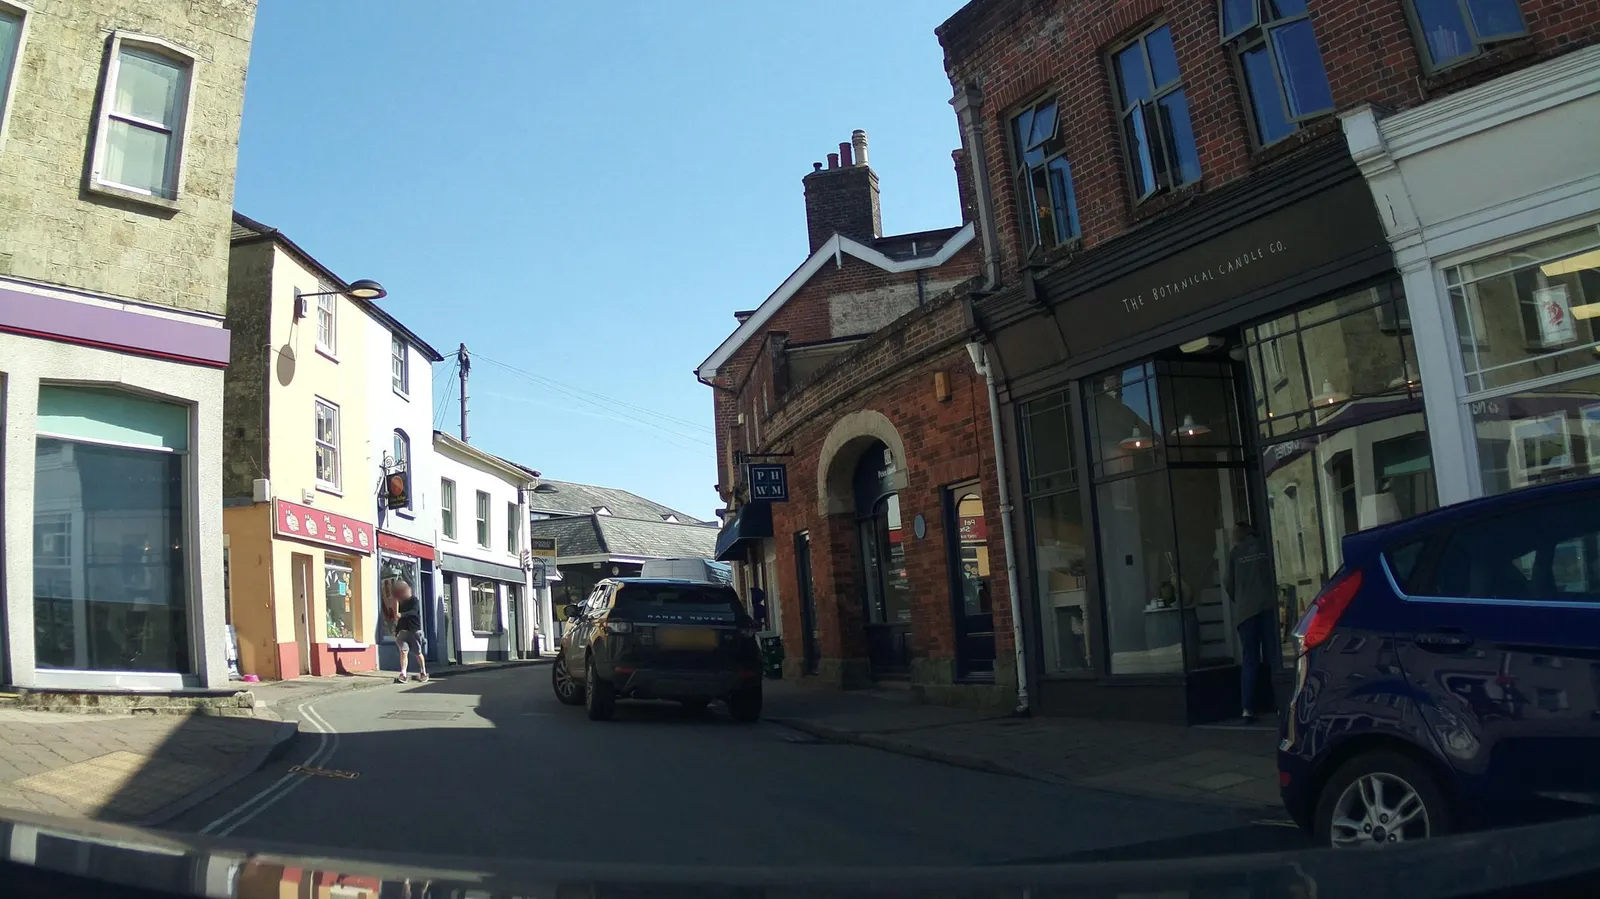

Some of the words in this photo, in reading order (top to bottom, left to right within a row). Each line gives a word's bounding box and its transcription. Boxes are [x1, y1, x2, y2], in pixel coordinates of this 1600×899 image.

[1122, 295, 1145, 313] THE
[1152, 269, 1214, 301] BOTANICAL
[1218, 248, 1264, 275] CANDLE
[1269, 241, 1287, 254] CO.
